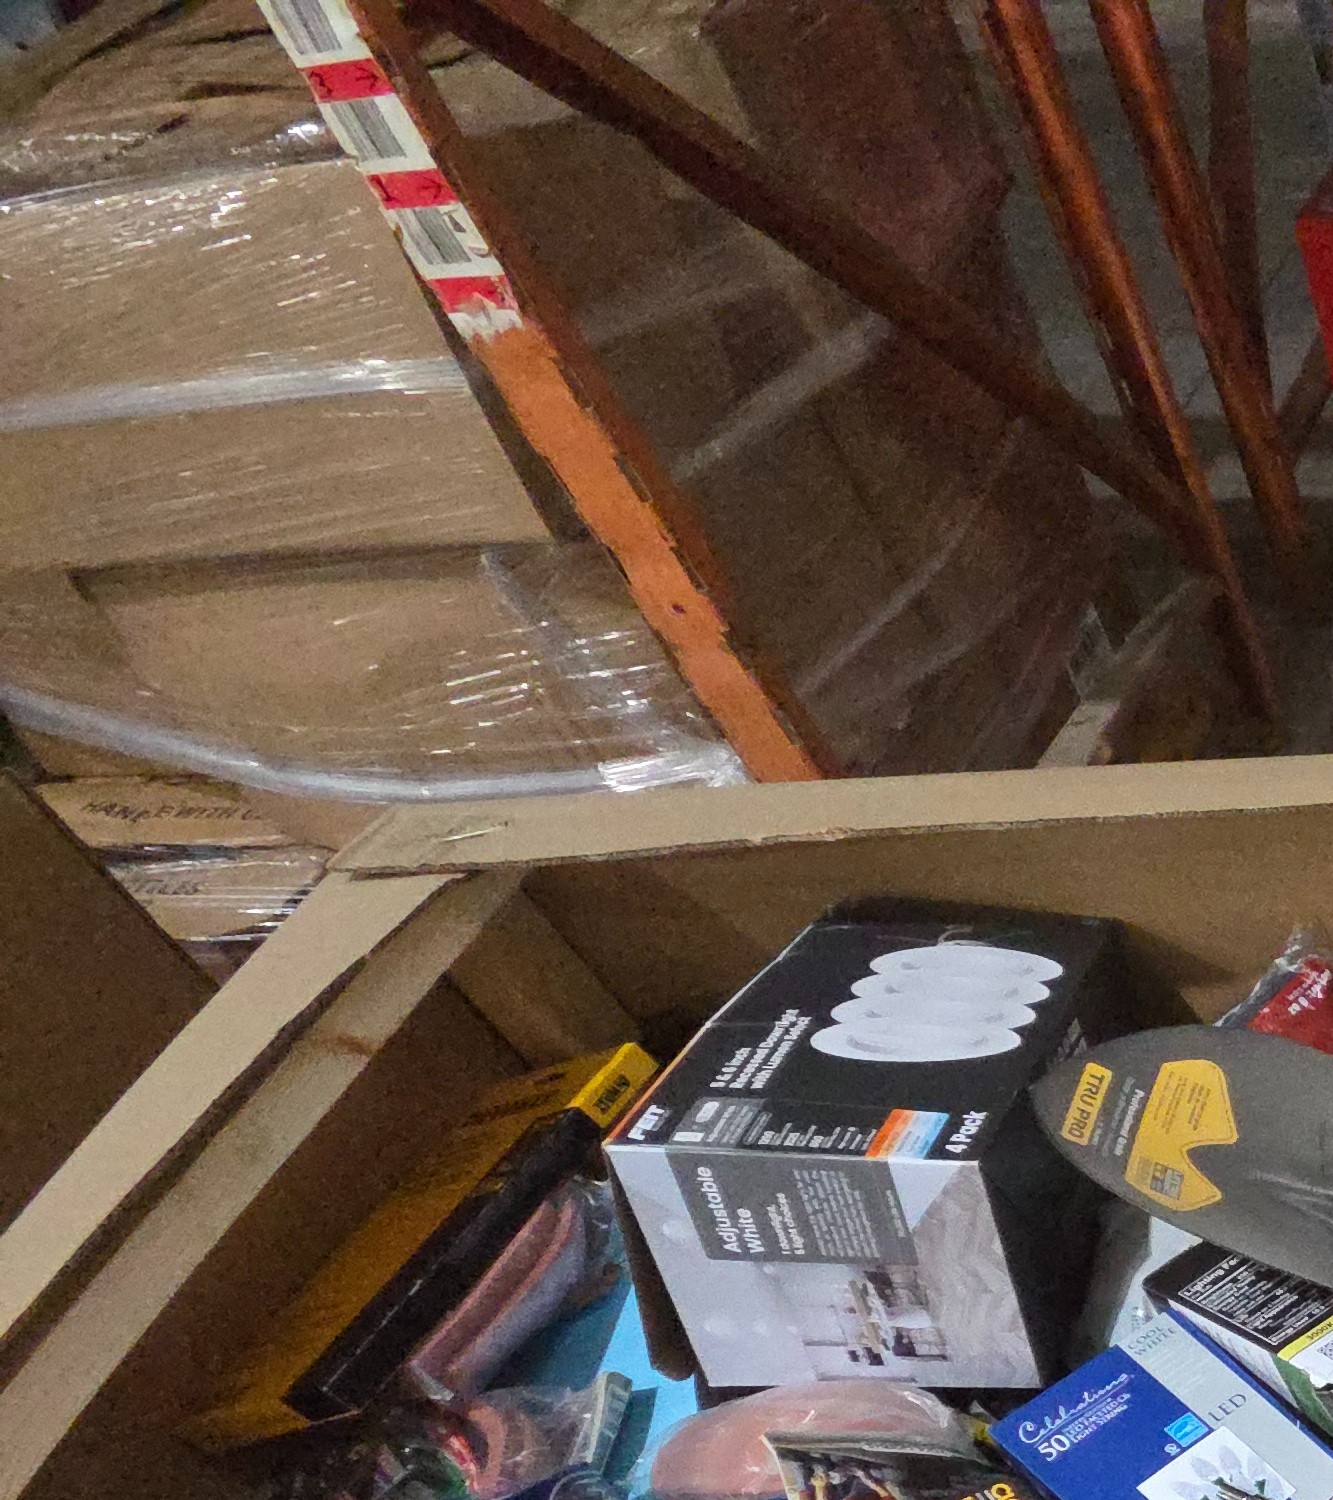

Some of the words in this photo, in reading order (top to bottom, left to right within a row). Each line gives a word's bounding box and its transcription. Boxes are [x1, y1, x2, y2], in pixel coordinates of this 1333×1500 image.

[1078, 1072, 1106, 1109] TRU
[951, 1110, 990, 1144] Pack
[1067, 1106, 1092, 1139] PRO
[944, 1140, 967, 1154] 4
[696, 1166, 742, 1254] Adjustable
[736, 1207, 764, 1255] White
[1127, 1325, 1167, 1351] COOL
[1018, 1373, 1129, 1444] Celebrations
[1208, 1392, 1248, 1424] LED
[1036, 1433, 1072, 1462] 50
